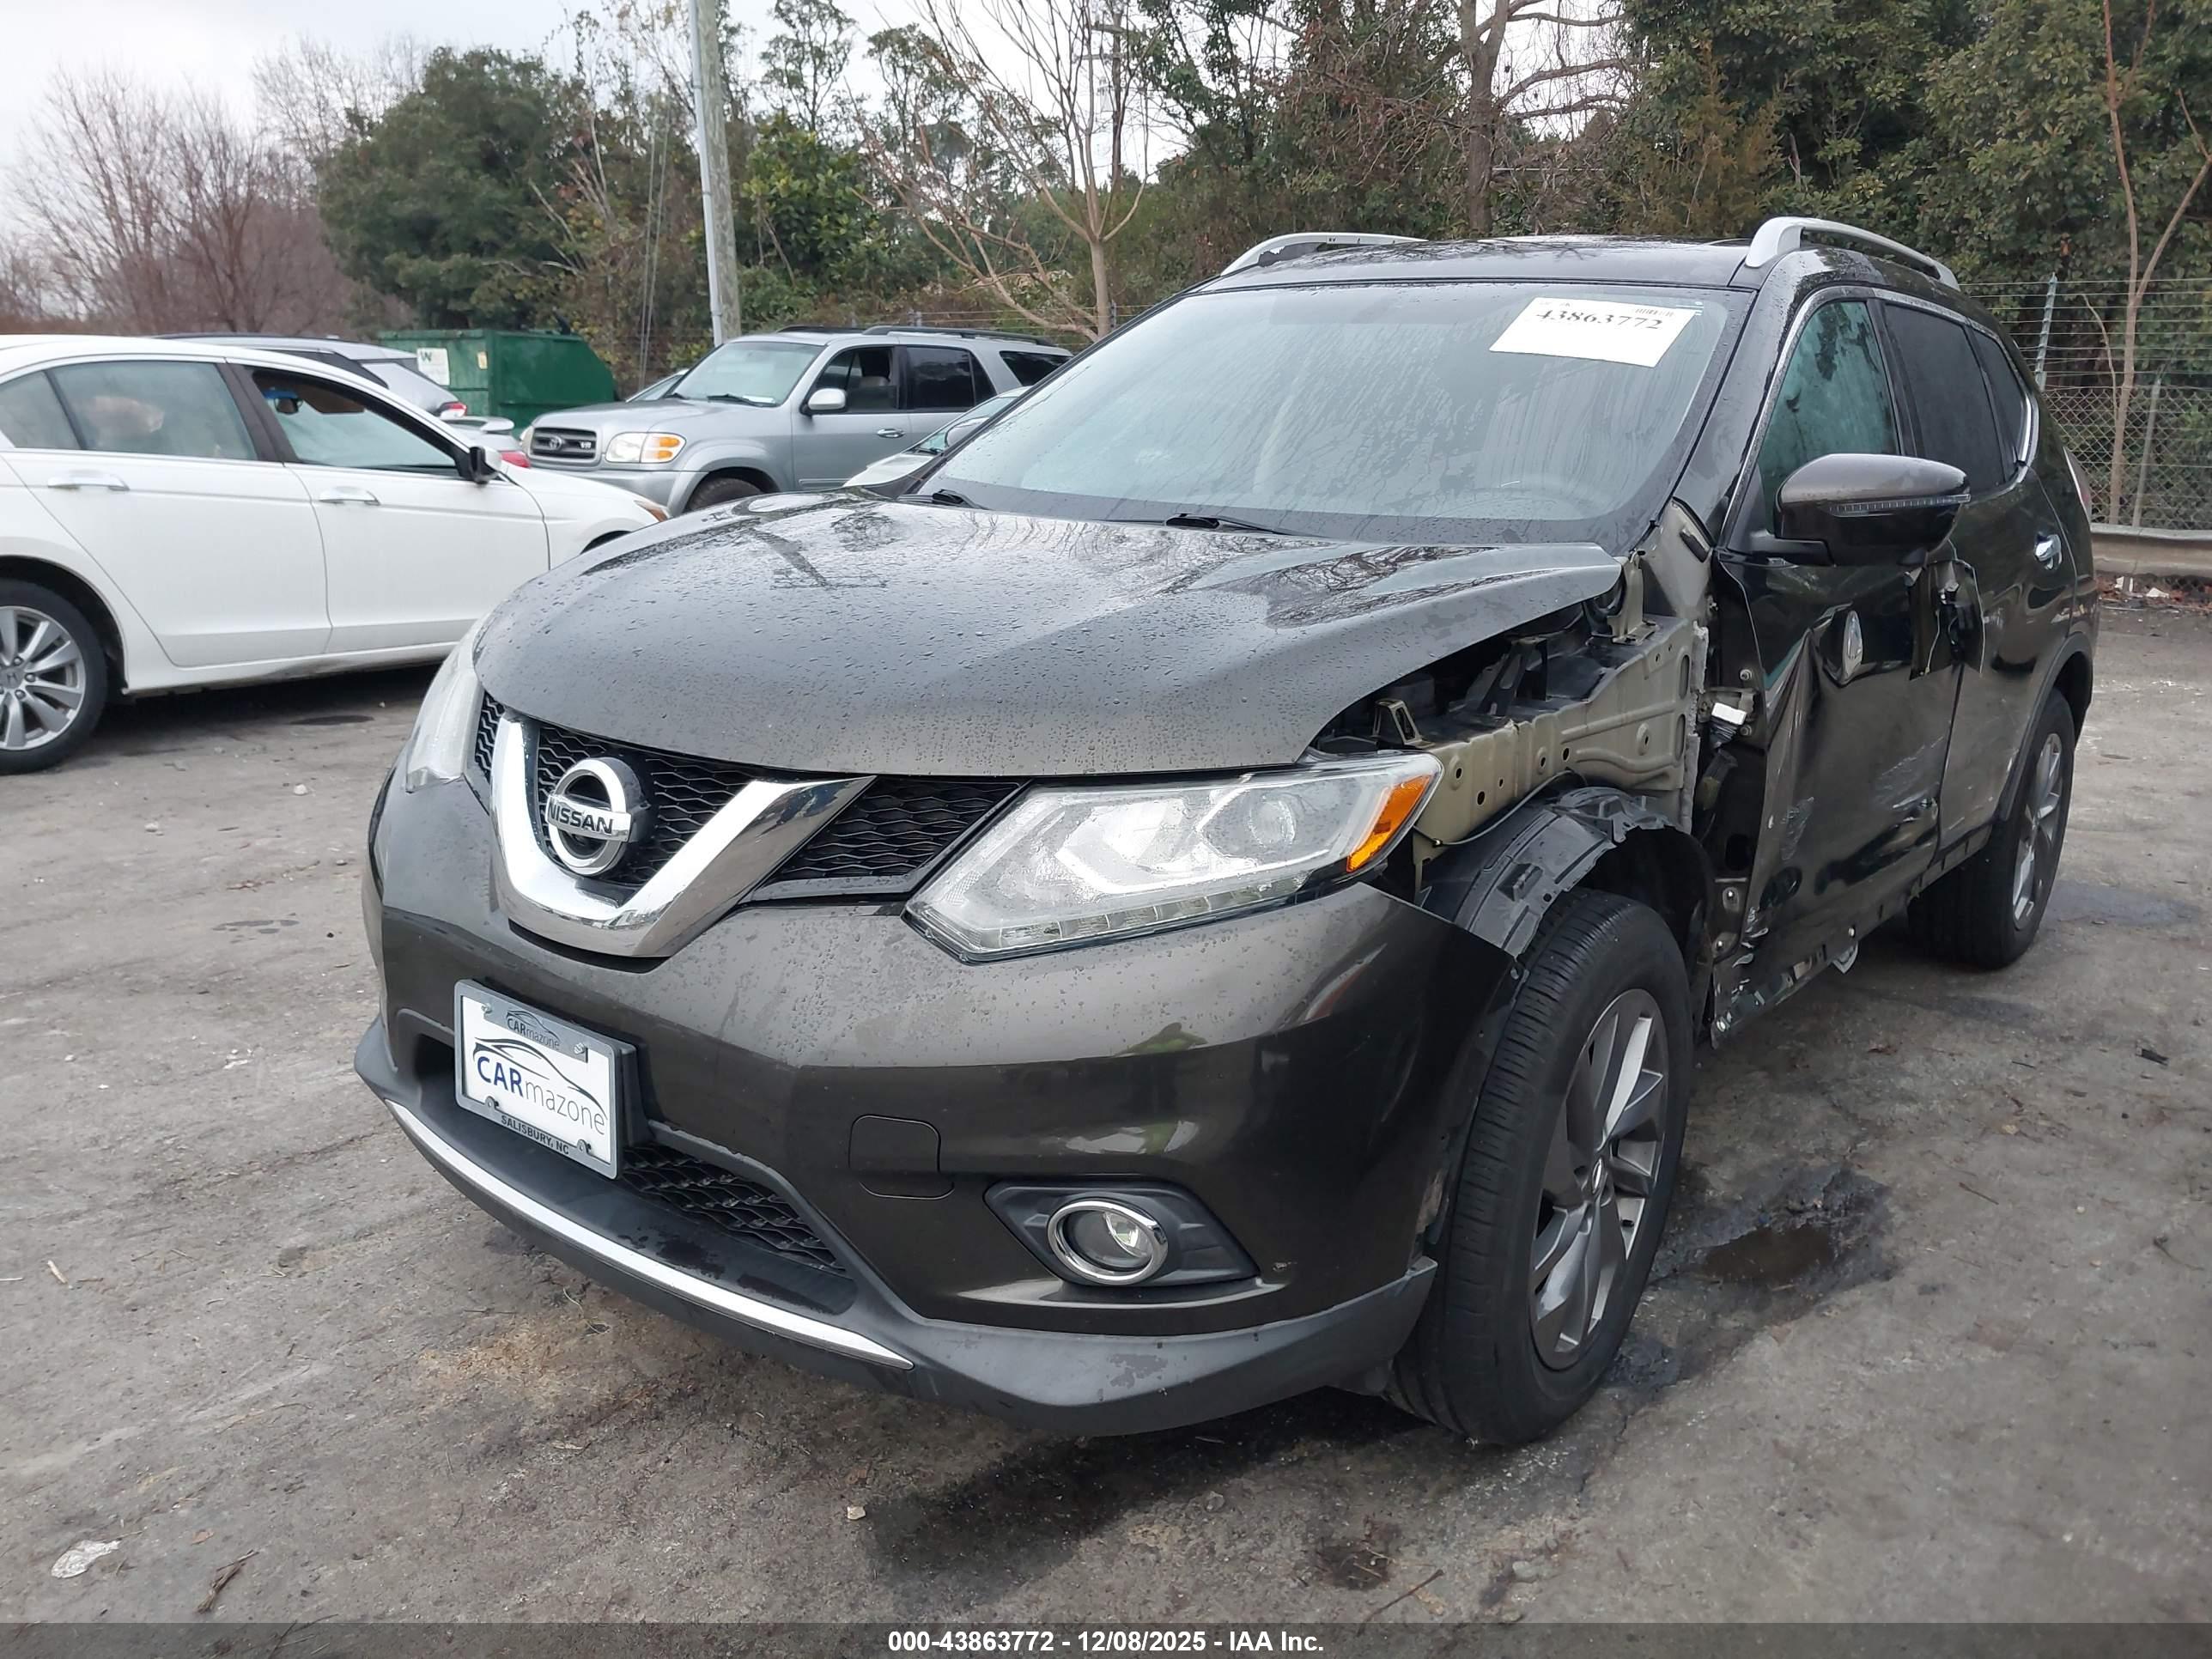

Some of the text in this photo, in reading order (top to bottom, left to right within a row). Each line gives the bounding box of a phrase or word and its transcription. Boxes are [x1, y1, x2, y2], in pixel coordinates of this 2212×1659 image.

[1536, 309, 1663, 330] 43863772
[548, 804, 613, 835] NISSAN
[507, 1018, 560, 1051] CARmazone
[477, 1056, 605, 1135] CARmazone
[501, 1115, 569, 1155] SALISBURY, NC
